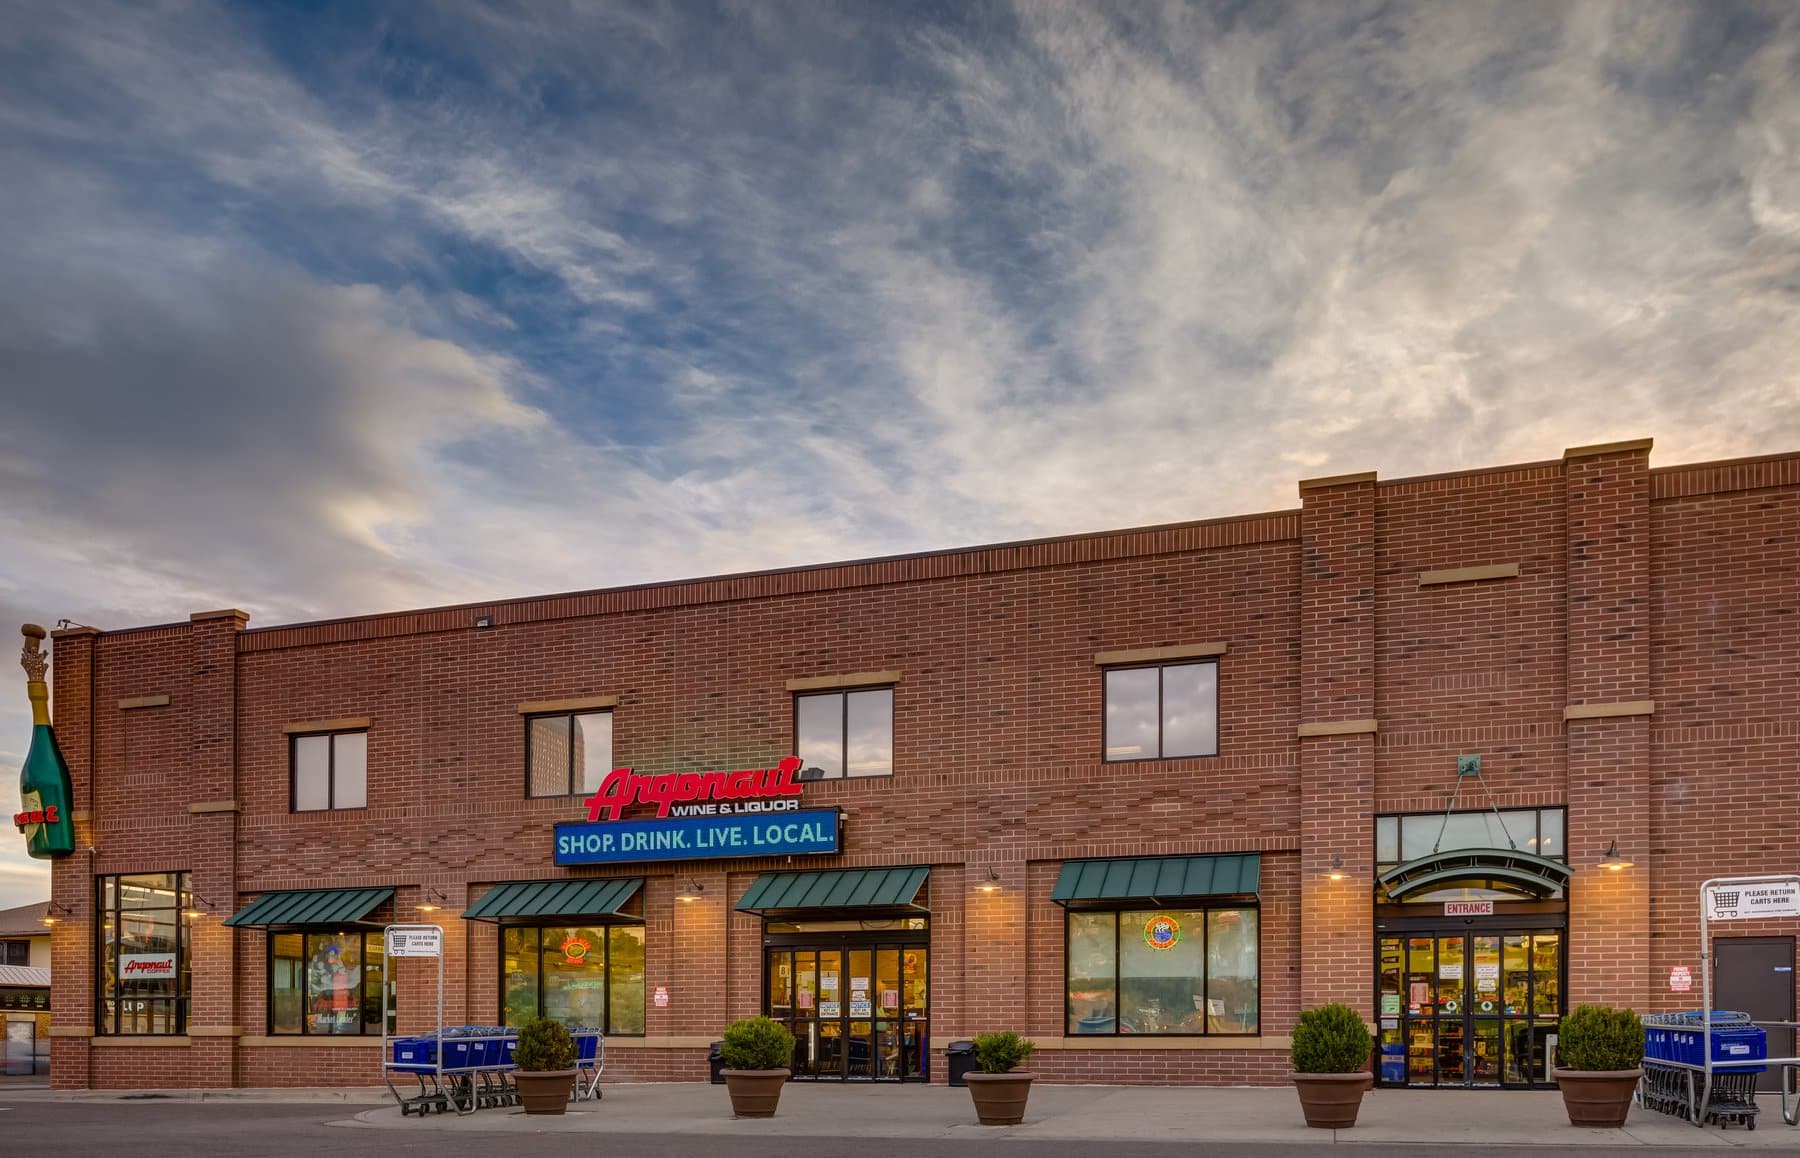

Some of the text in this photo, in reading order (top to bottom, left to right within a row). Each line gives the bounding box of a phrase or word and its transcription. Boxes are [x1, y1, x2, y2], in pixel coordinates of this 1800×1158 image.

[583, 755, 803, 822] Argonaut
[671, 799, 799, 817] WINE & LIQUOR
[558, 822, 834, 855] SHOP. DRINK. LIVE. LOCAL.
[1744, 888, 1796, 897] PLEASE RETURN
[1447, 903, 1491, 914] ENTRANCE
[124, 959, 173, 974] Argonaut
